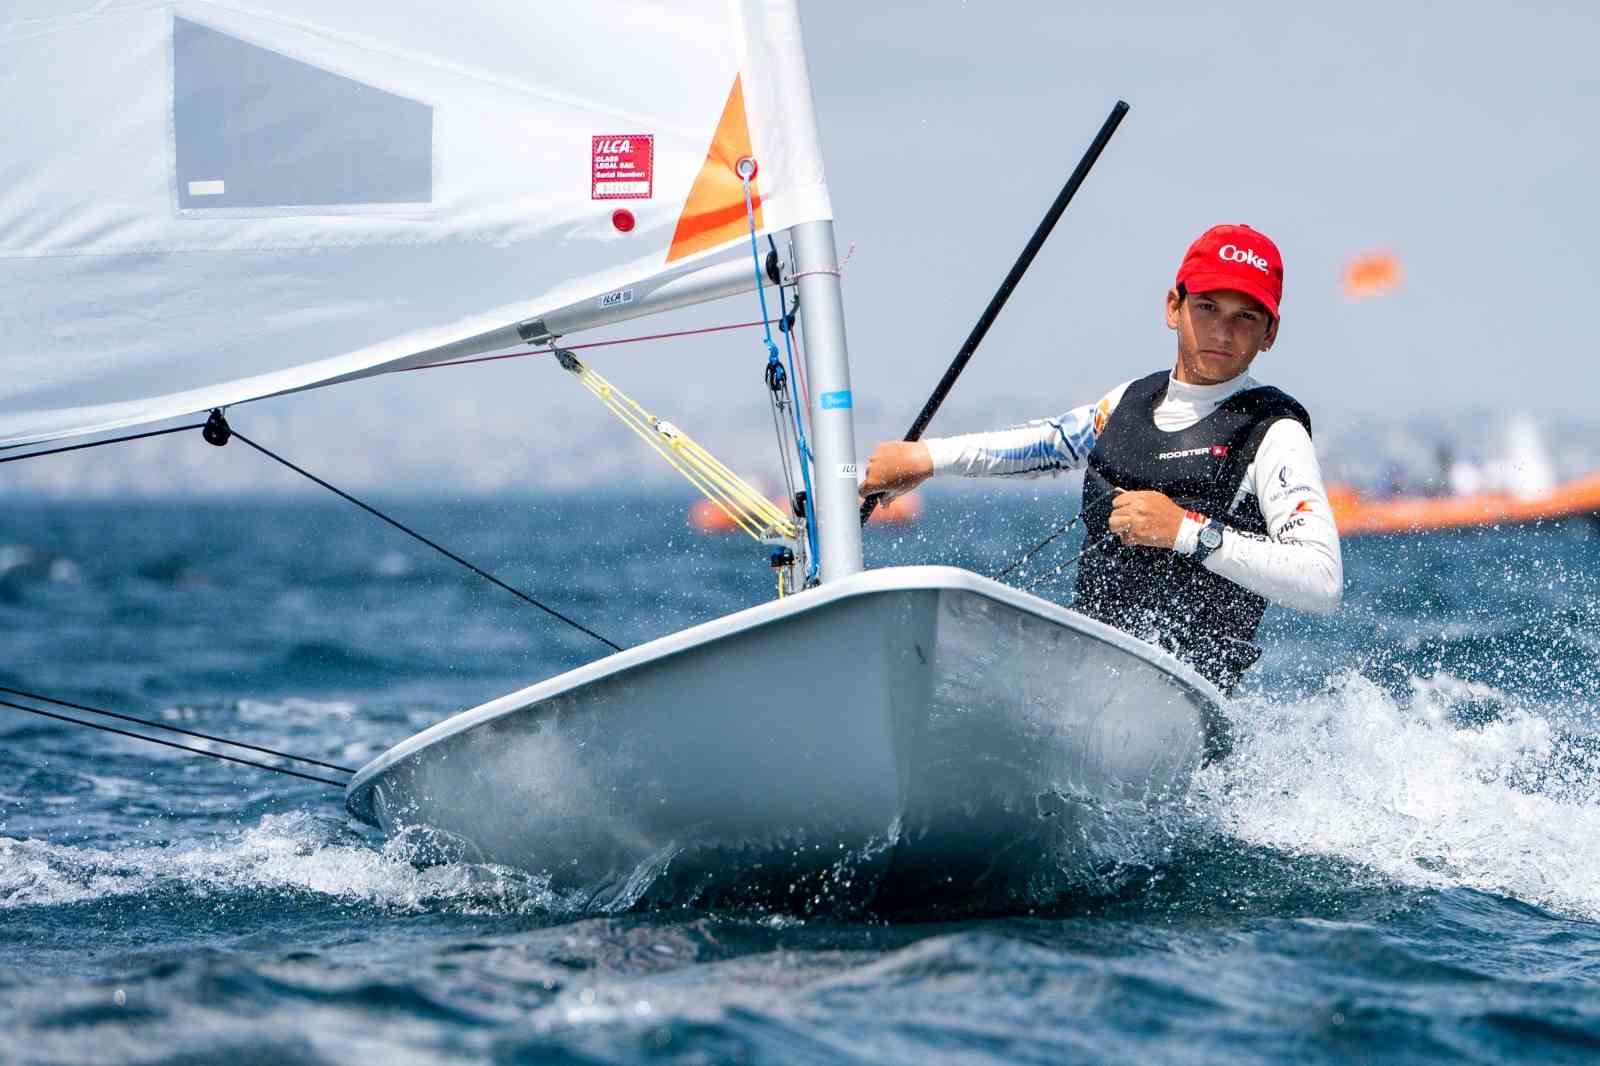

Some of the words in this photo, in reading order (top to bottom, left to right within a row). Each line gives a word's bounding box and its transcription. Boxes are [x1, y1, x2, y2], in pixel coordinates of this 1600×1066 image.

[1219, 244, 1268, 272] Coke
[603, 293, 621, 304] ILCA
[1159, 447, 1210, 460] ROOSTER
